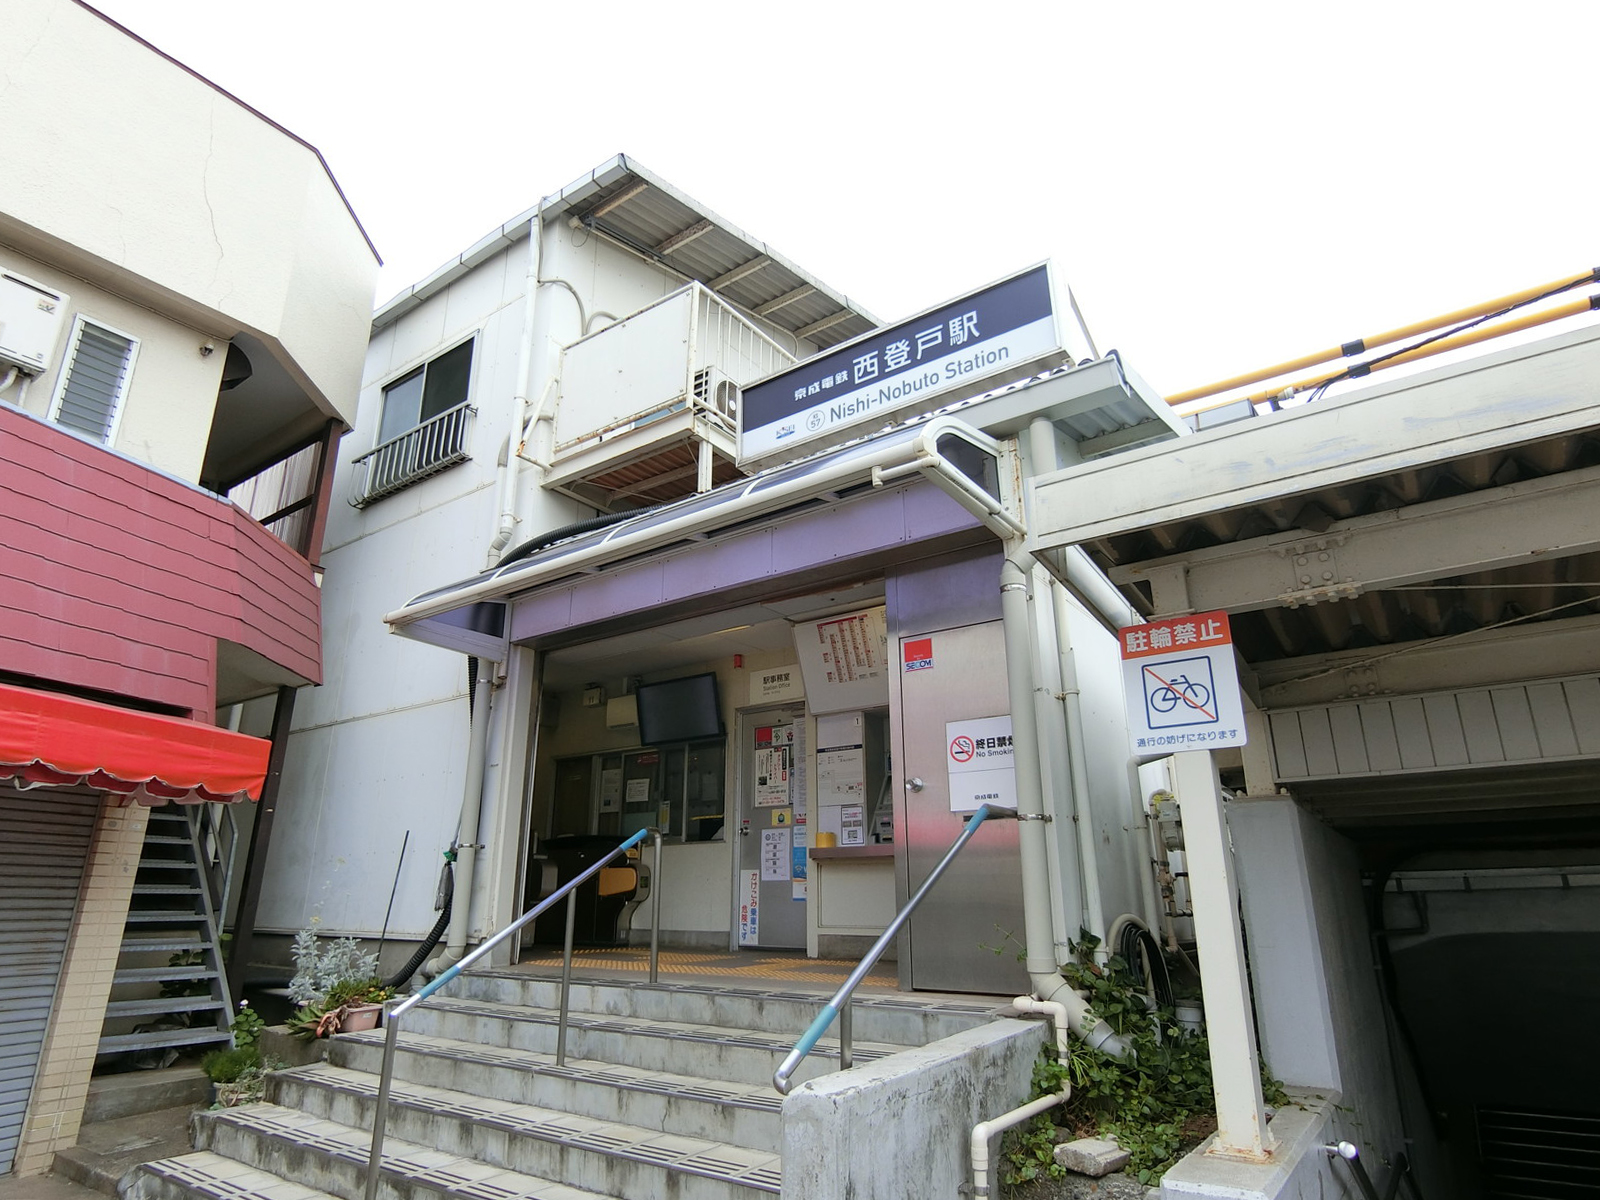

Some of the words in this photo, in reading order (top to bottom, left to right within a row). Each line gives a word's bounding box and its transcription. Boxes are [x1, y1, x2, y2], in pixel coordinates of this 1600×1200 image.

[794, 369, 849, 402] 京成電鉄
[852, 309, 980, 385] 西登戸駅
[829, 371, 939, 423] Nishi-Nobuto
[945, 345, 1010, 380] Station
[810, 418, 821, 429] 57
[1125, 618, 1224, 653] 駐輪禁止
[905, 659, 932, 670] SECOM
[1136, 728, 1238, 748] 通行の妨げになります
[975, 750, 986, 758] No
